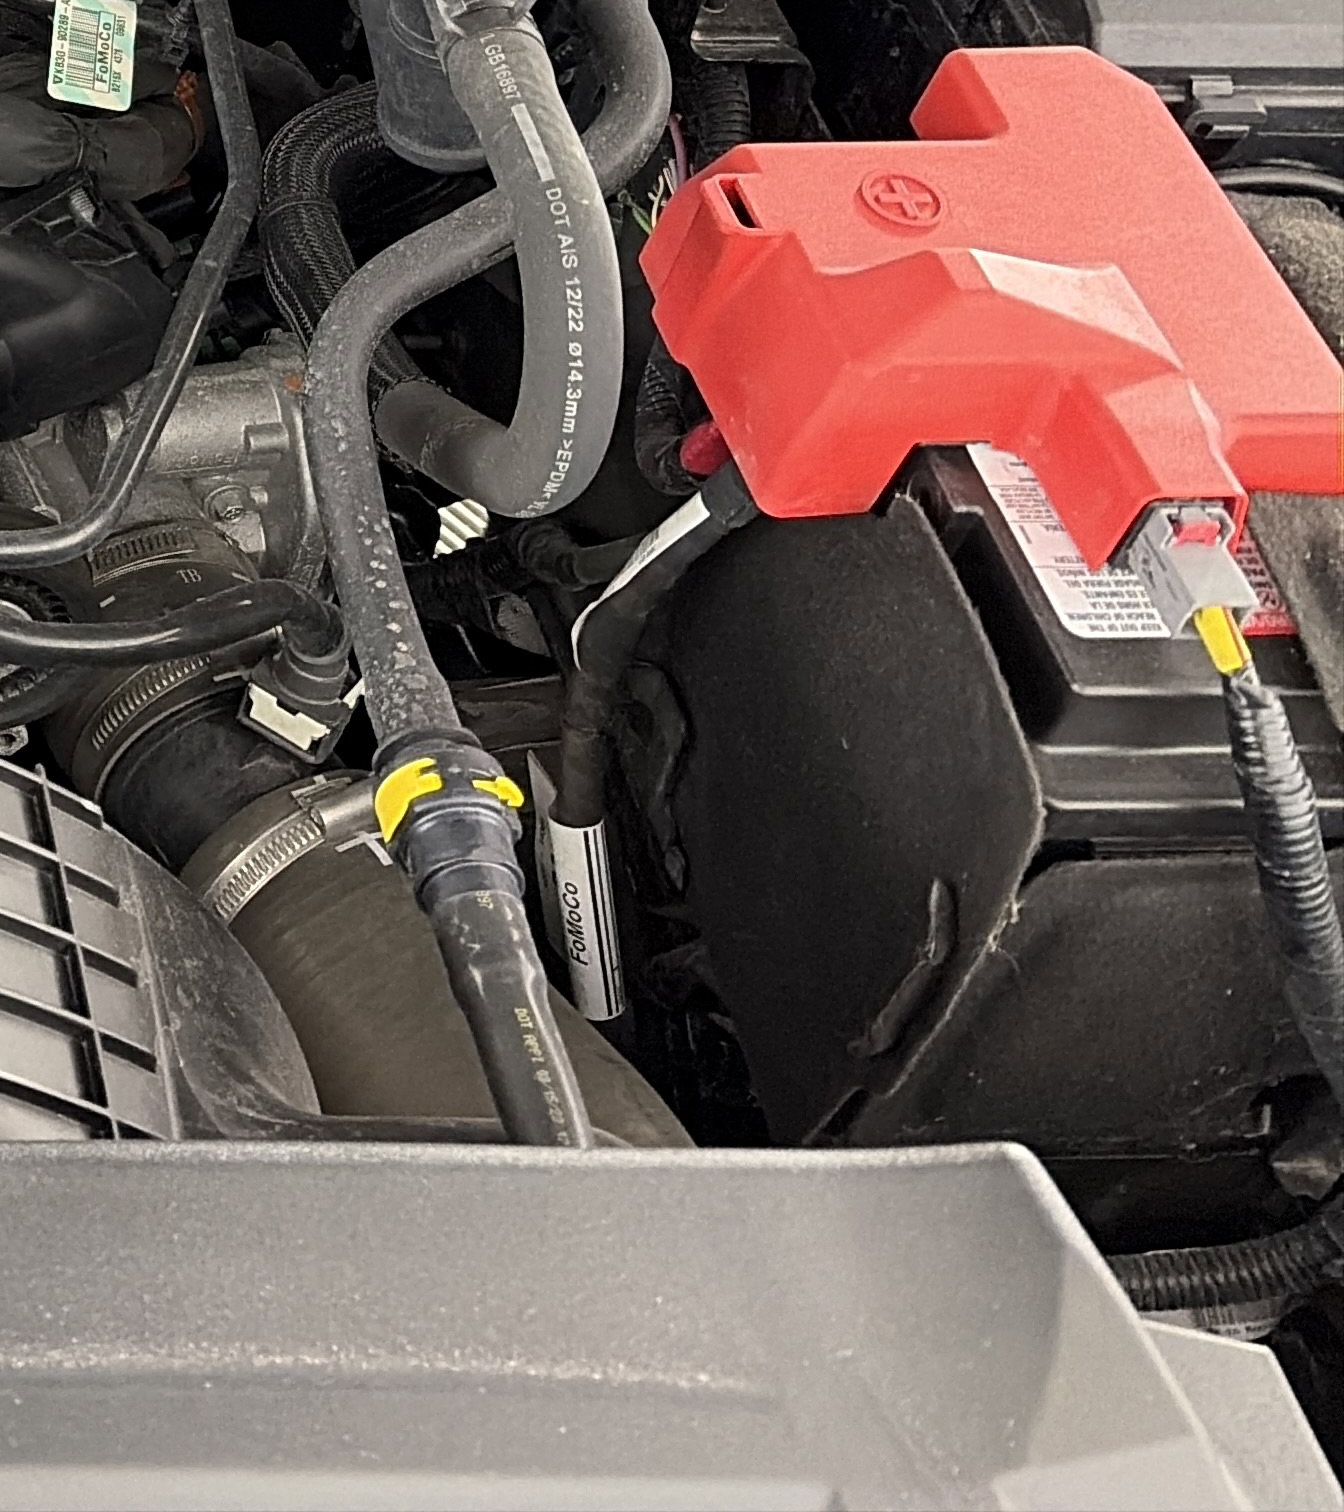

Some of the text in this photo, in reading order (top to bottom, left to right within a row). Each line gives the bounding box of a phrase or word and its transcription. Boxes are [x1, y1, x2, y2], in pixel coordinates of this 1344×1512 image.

[96, 22, 112, 84] FoMoCo
[545, 187, 571, 228] DOT
[565, 277, 584, 333] 12/22
[176, 569, 202, 583] TB
[1126, 612, 1155, 621] REACH
[562, 882, 589, 966] FoMoCo
